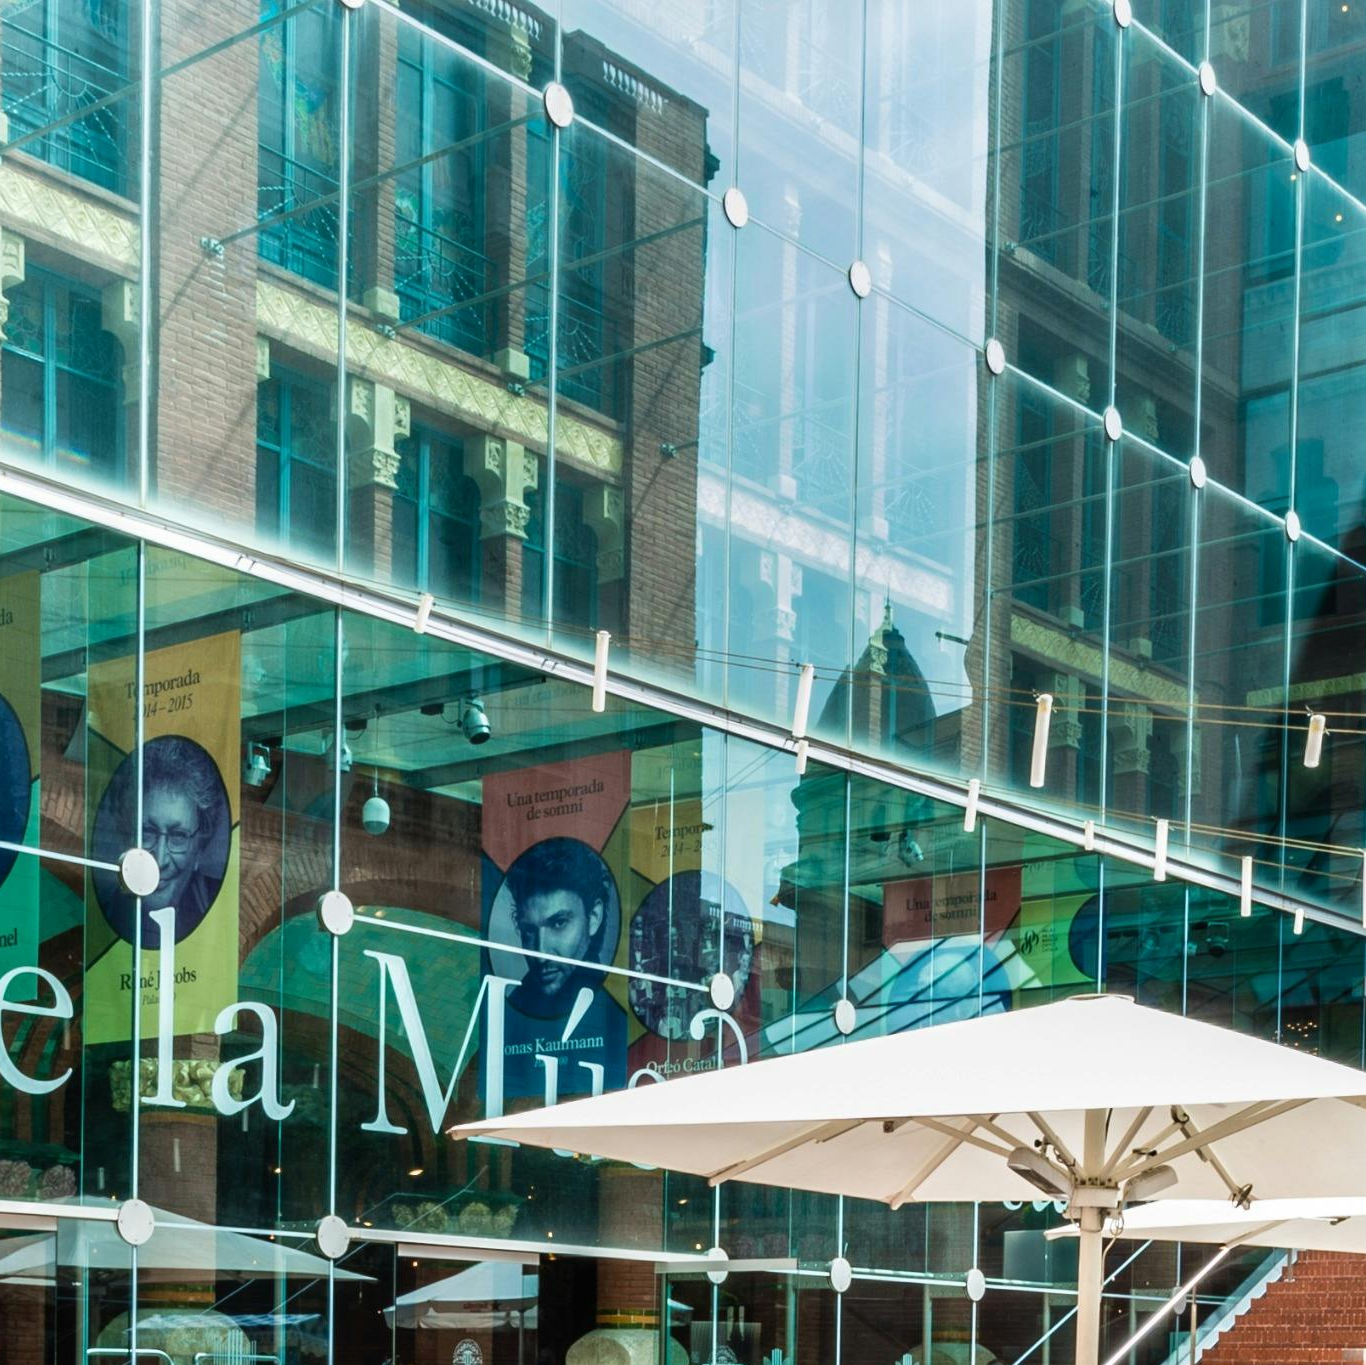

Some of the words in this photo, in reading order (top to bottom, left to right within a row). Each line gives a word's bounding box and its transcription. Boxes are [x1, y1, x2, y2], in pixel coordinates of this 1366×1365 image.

[507, 792, 533, 808] Una
[535, 779, 604, 804] temporada
[526, 807, 541, 821] de
[543, 799, 583, 818] somni
[141, 906, 295, 1121] la
[504, 1042, 533, 1055] onas
